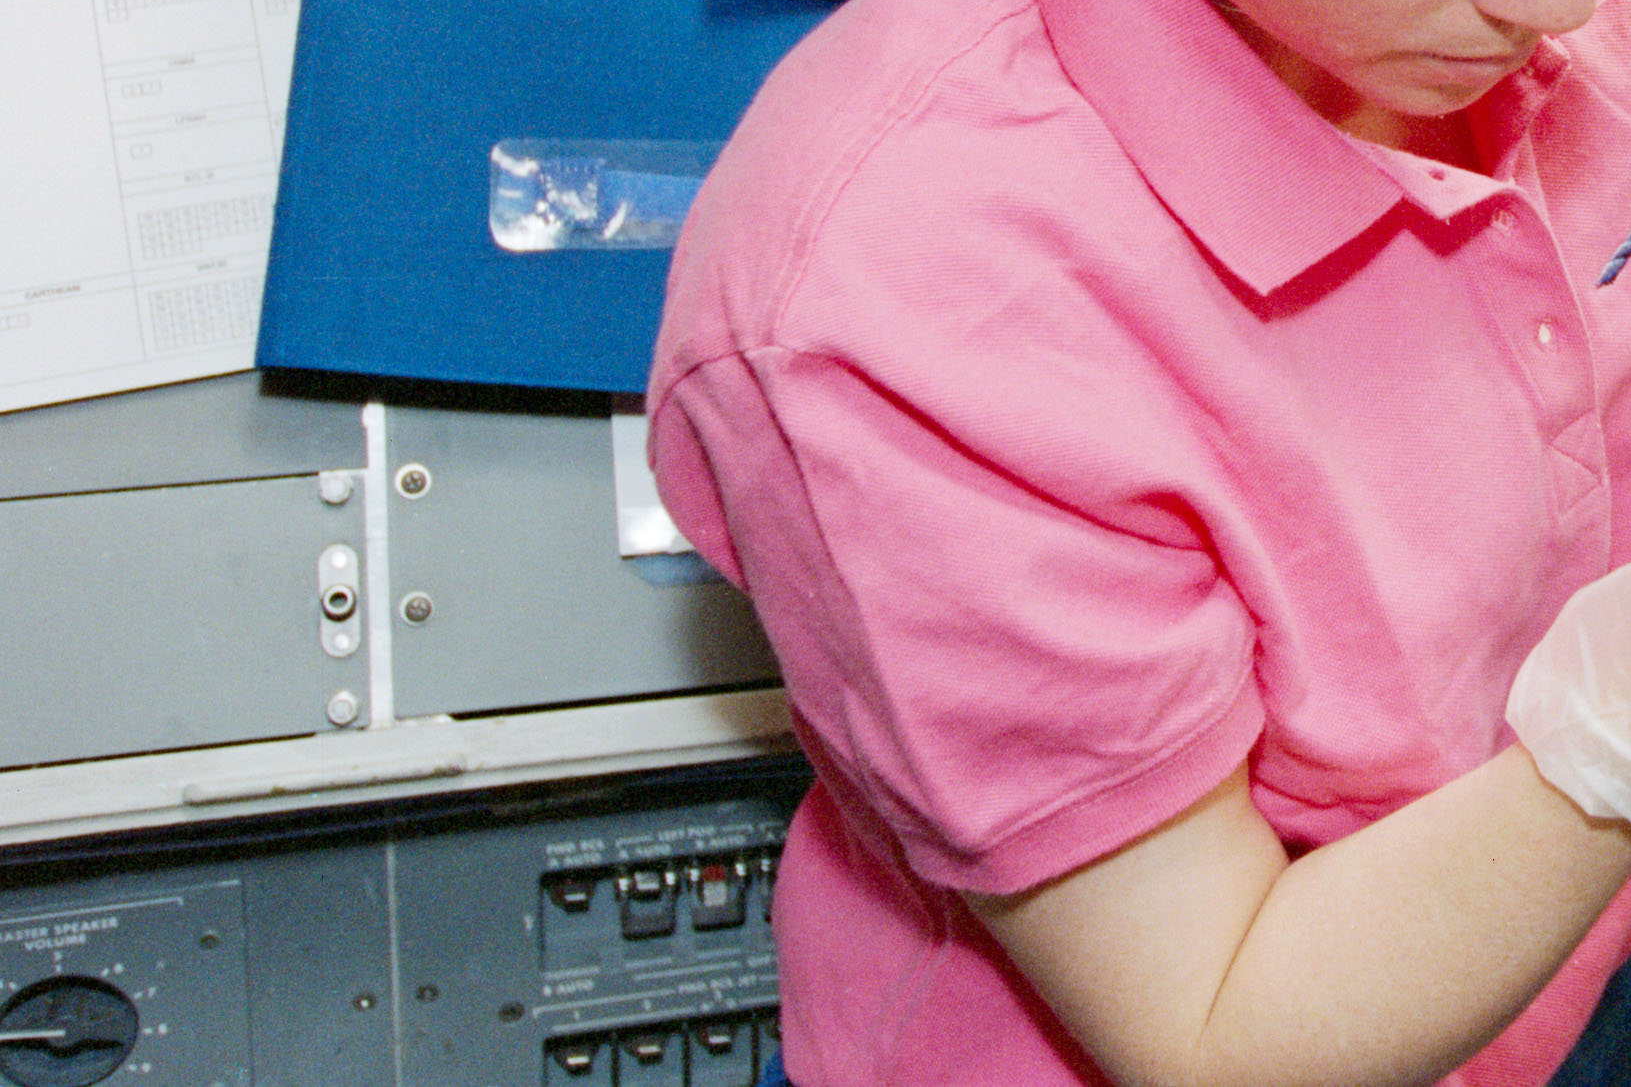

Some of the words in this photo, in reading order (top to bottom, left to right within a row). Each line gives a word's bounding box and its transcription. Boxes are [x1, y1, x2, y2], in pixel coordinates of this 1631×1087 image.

[0, 926, 49, 943] ASTER
[53, 916, 119, 934] SPEAKER
[24, 933, 87, 951] VOLUME
[556, 978, 594, 994] AUTO
